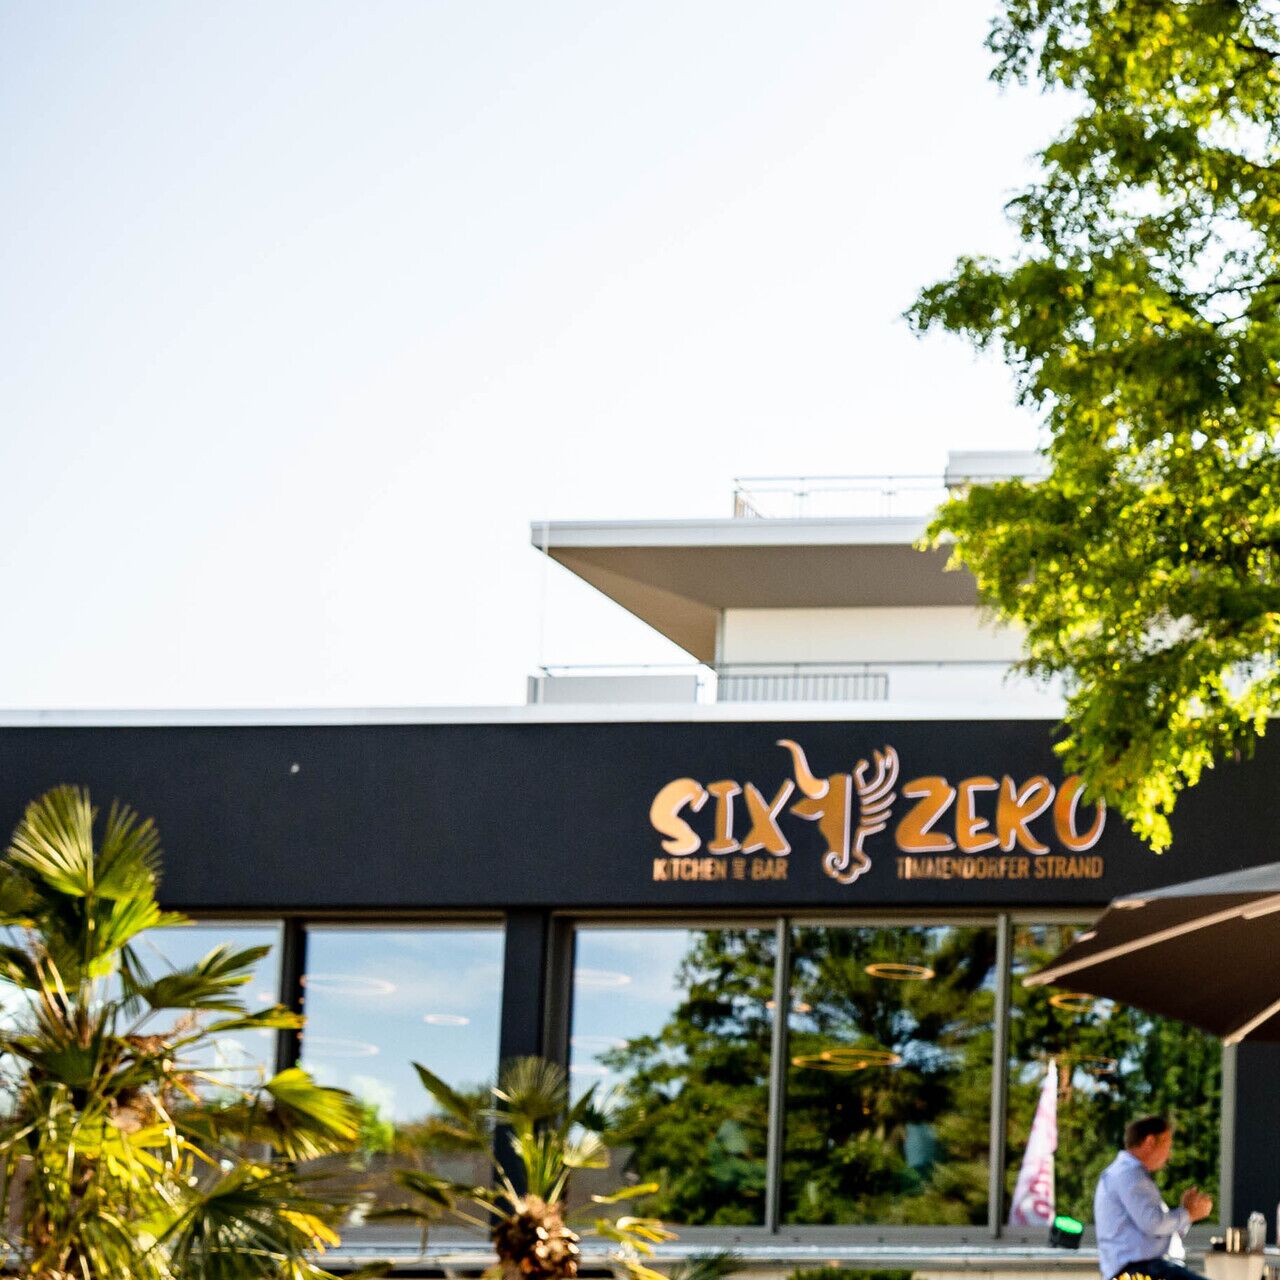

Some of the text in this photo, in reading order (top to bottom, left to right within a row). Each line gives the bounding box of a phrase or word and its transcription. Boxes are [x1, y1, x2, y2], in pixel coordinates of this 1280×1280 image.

[649, 775, 1107, 855] SIX ZERO
[652, 857, 728, 881] KITCHEN
[751, 858, 789, 881] BAR
[1034, 856, 1105, 880] STRAND
